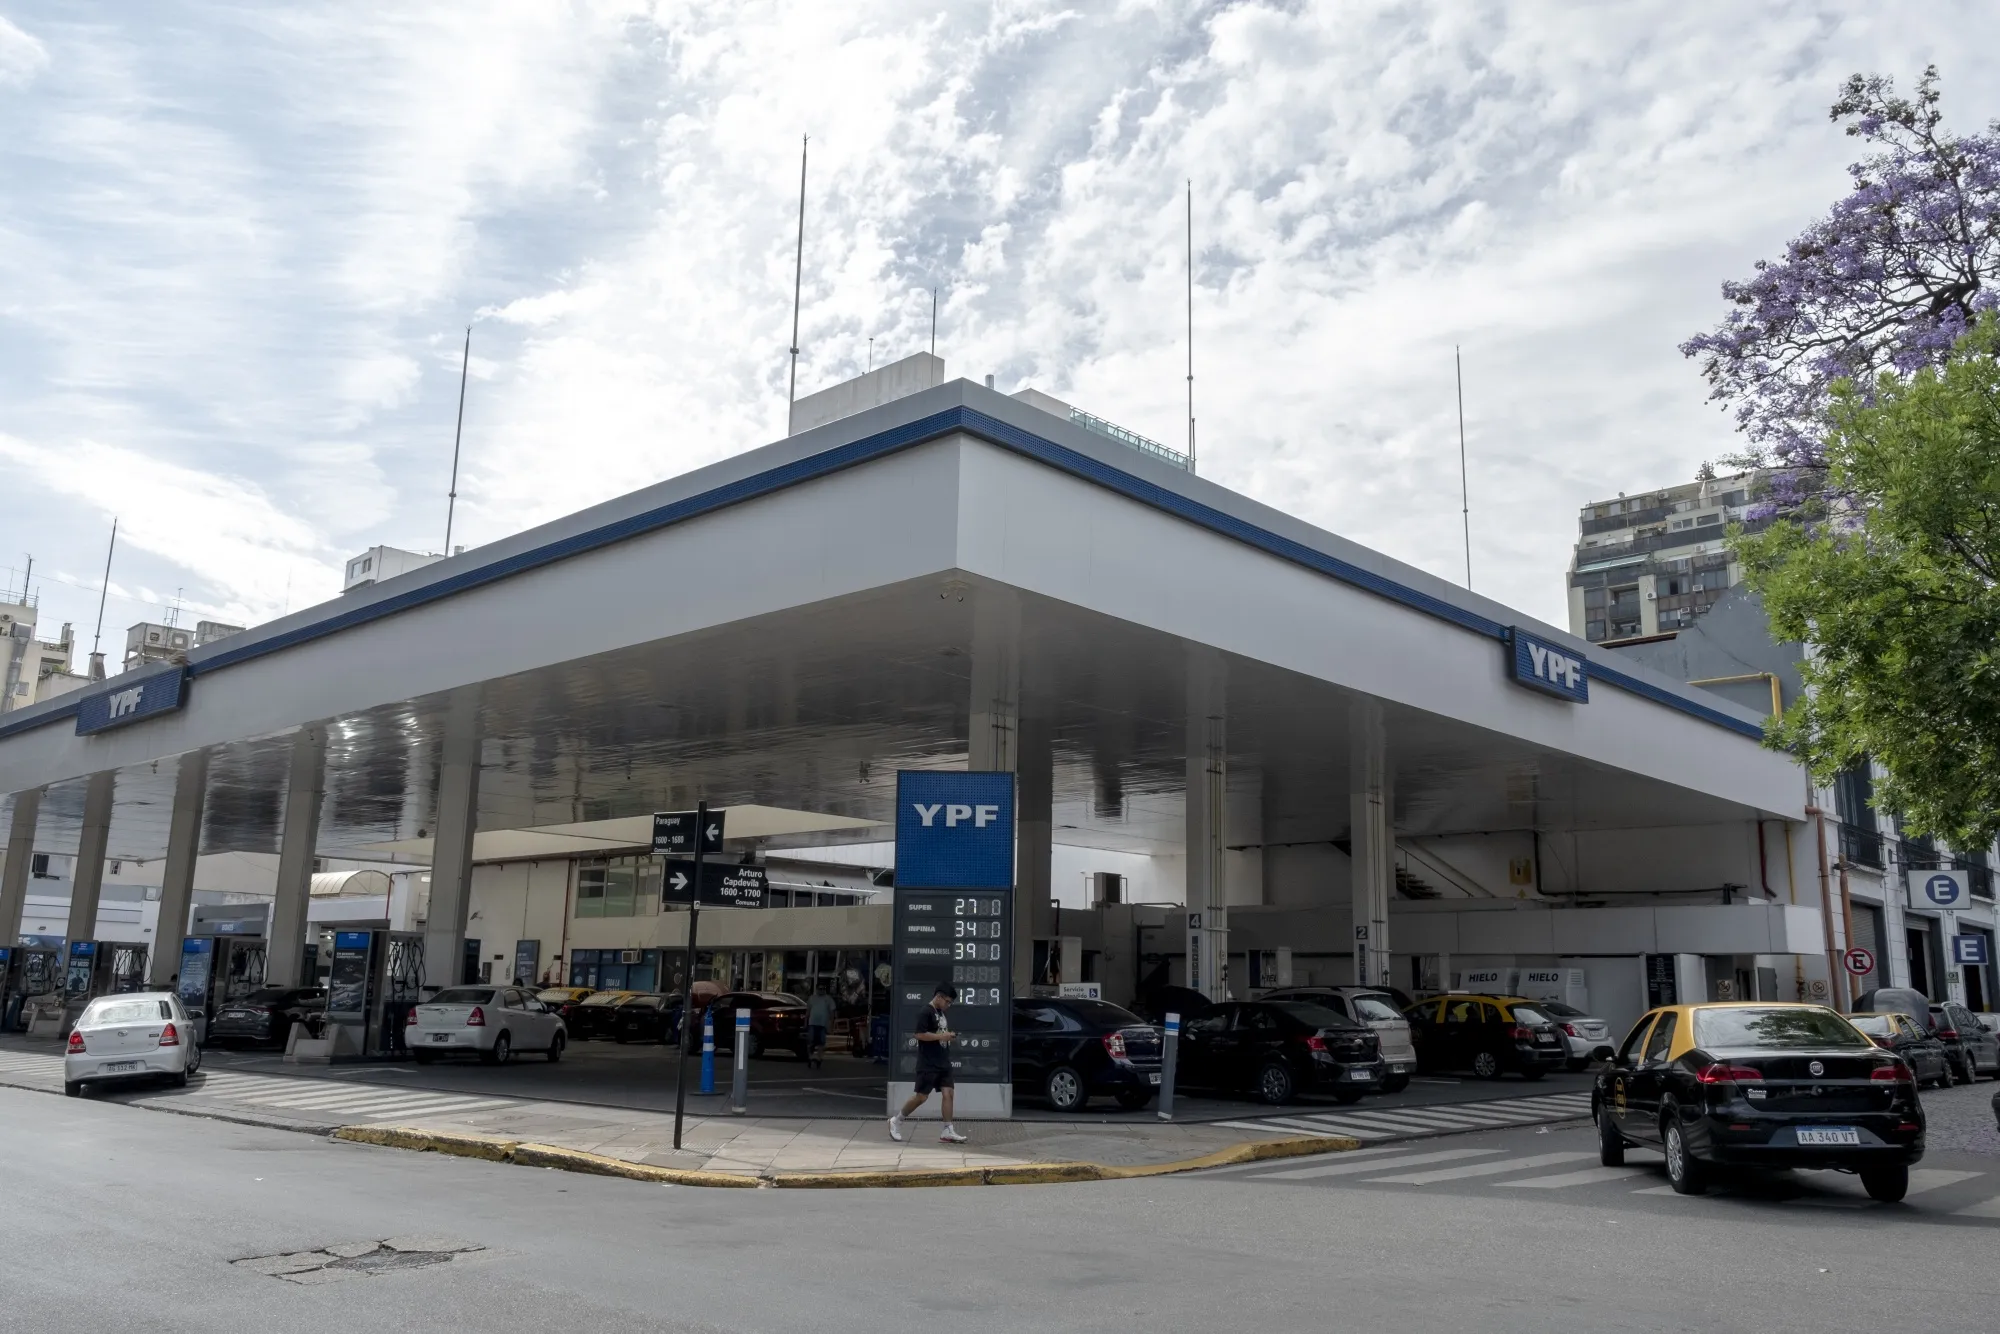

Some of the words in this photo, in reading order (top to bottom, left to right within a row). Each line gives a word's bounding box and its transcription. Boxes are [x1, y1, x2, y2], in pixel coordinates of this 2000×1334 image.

[1527, 642, 1580, 689] YPF
[110, 686, 143, 719] YPF
[656, 816, 681, 826] Paraguay
[912, 803, 999, 828] YPF
[655, 836, 668, 844] 1600
[738, 868, 762, 878] Arturo
[723, 876, 759, 888] Capdevila
[720, 888, 738, 896] 1600
[744, 888, 761, 898] 1700
[1933, 880, 1952, 900] E
[1190, 914, 1200, 928] 4
[1358, 926, 1367, 939] 2
[1960, 940, 1980, 960] E
[1468, 973, 1498, 982] HIELO
[1528, 972, 1558, 982] HIELO
[1802, 1132, 1815, 1142] AA
[1817, 1132, 1839, 1142] 340
[1841, 1132, 1855, 1142] VT
